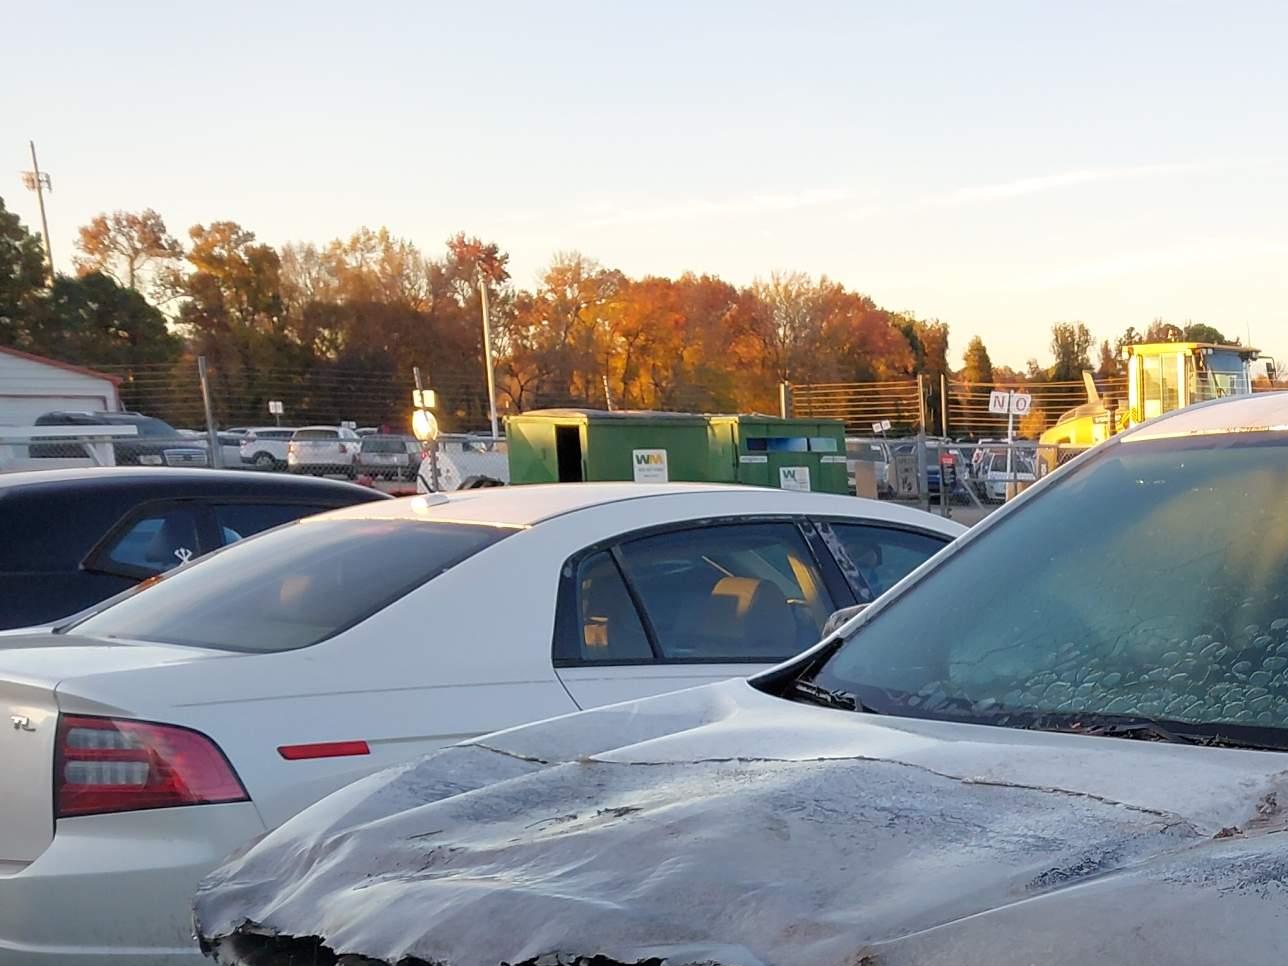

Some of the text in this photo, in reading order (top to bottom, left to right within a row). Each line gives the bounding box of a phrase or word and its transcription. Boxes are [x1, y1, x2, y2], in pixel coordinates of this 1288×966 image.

[993, 395, 1005, 409] N
[1016, 397, 1027, 411] O
[635, 454, 663, 464] WM
